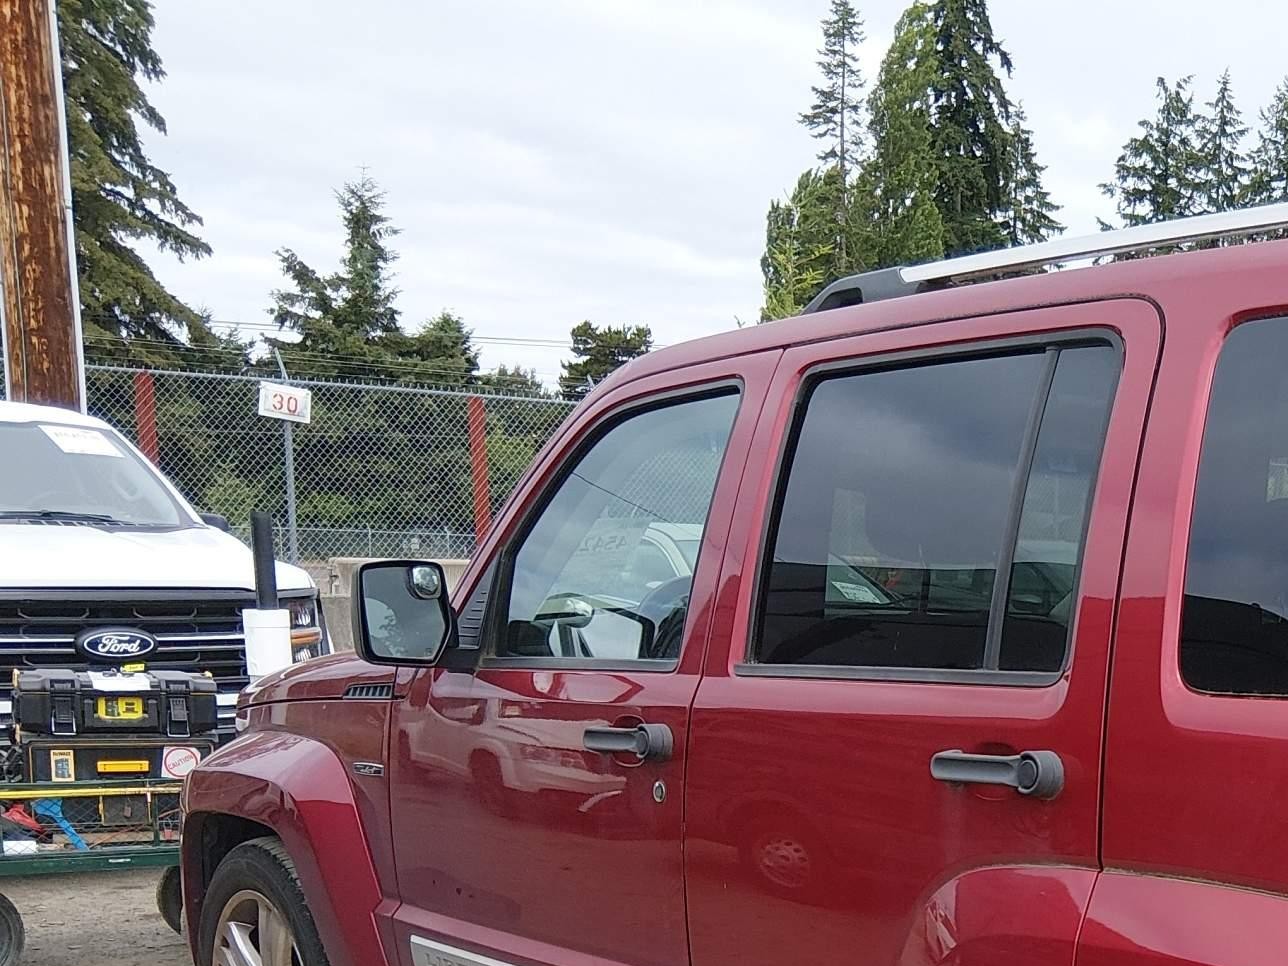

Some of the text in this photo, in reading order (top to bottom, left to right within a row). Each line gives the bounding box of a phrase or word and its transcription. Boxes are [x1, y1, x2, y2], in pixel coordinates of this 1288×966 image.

[272, 393, 298, 414] 30
[97, 635, 140, 653] Ford
[167, 753, 194, 770] CAUTION
